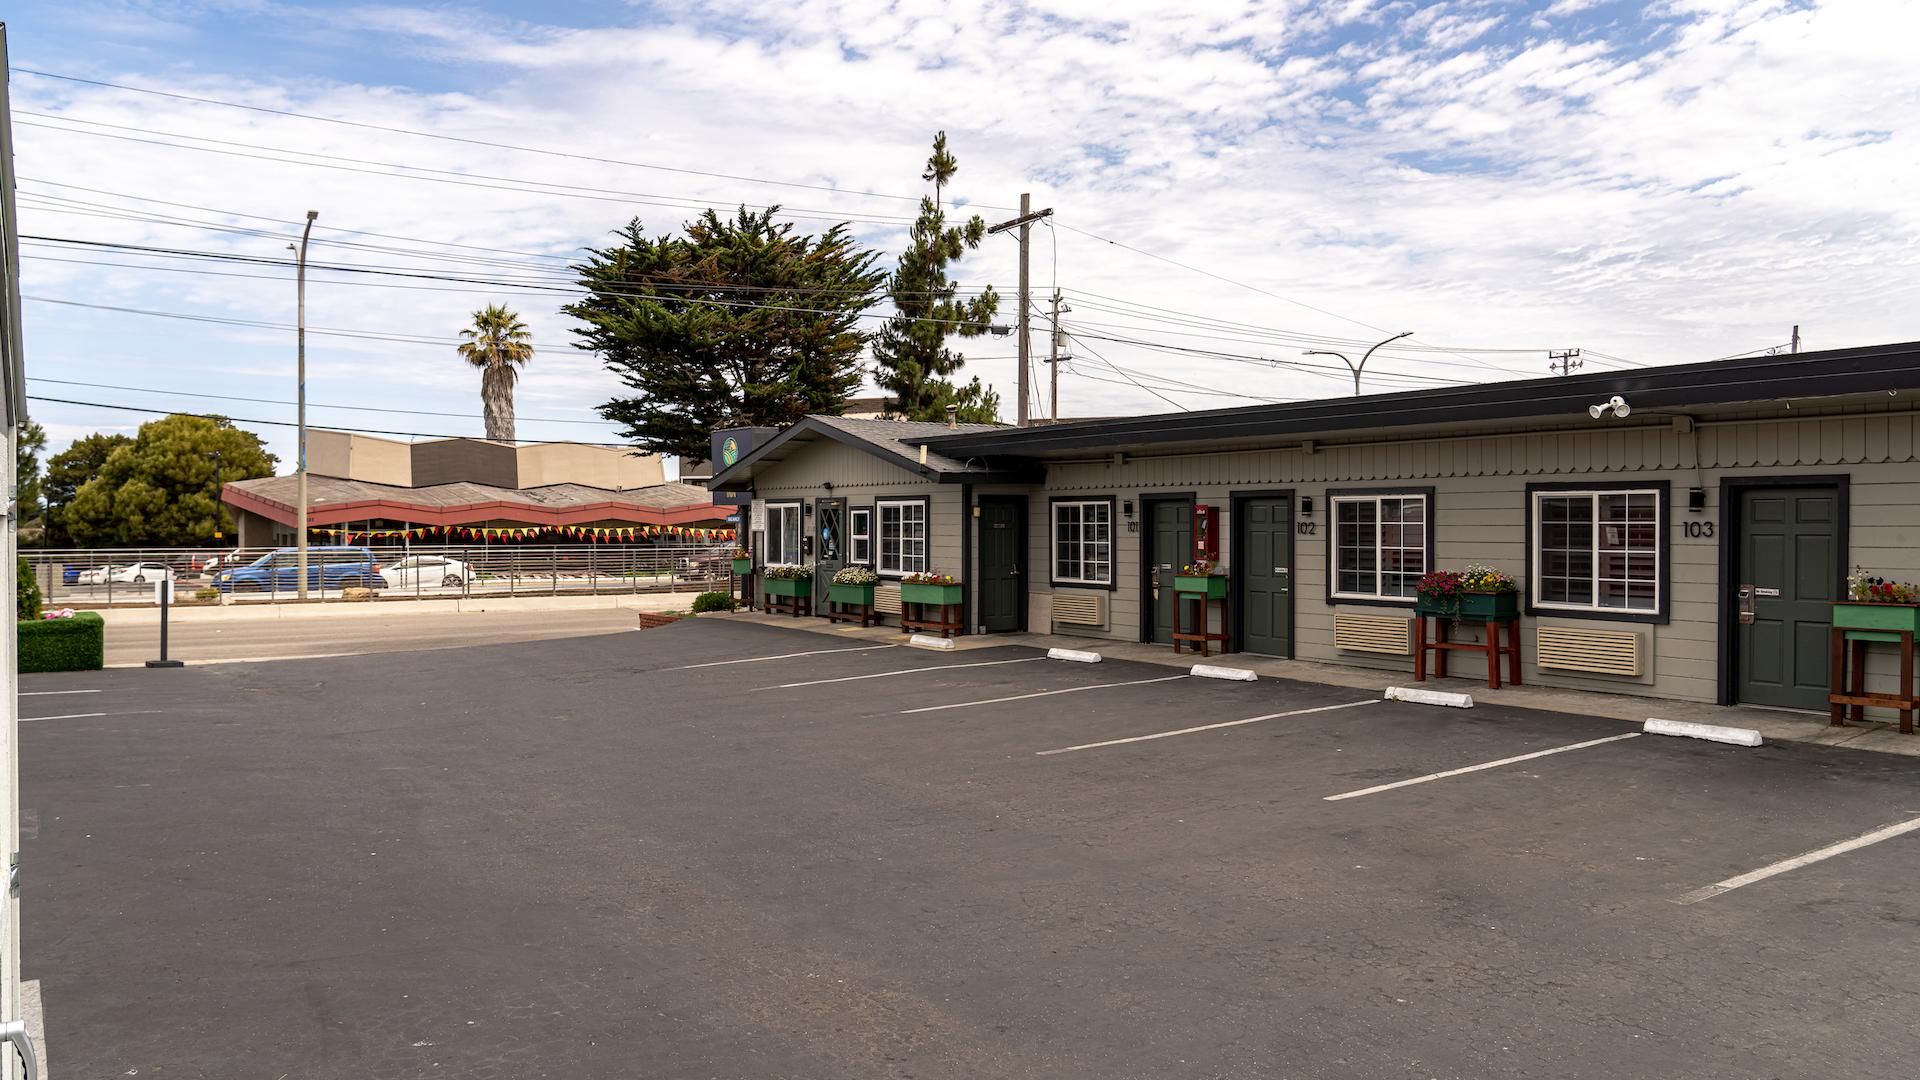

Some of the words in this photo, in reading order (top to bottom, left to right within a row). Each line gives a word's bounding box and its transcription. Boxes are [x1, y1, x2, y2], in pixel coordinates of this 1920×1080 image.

[1127, 521, 1138, 533] 101
[1297, 522, 1316, 535] 102
[1683, 521, 1714, 538] 103
